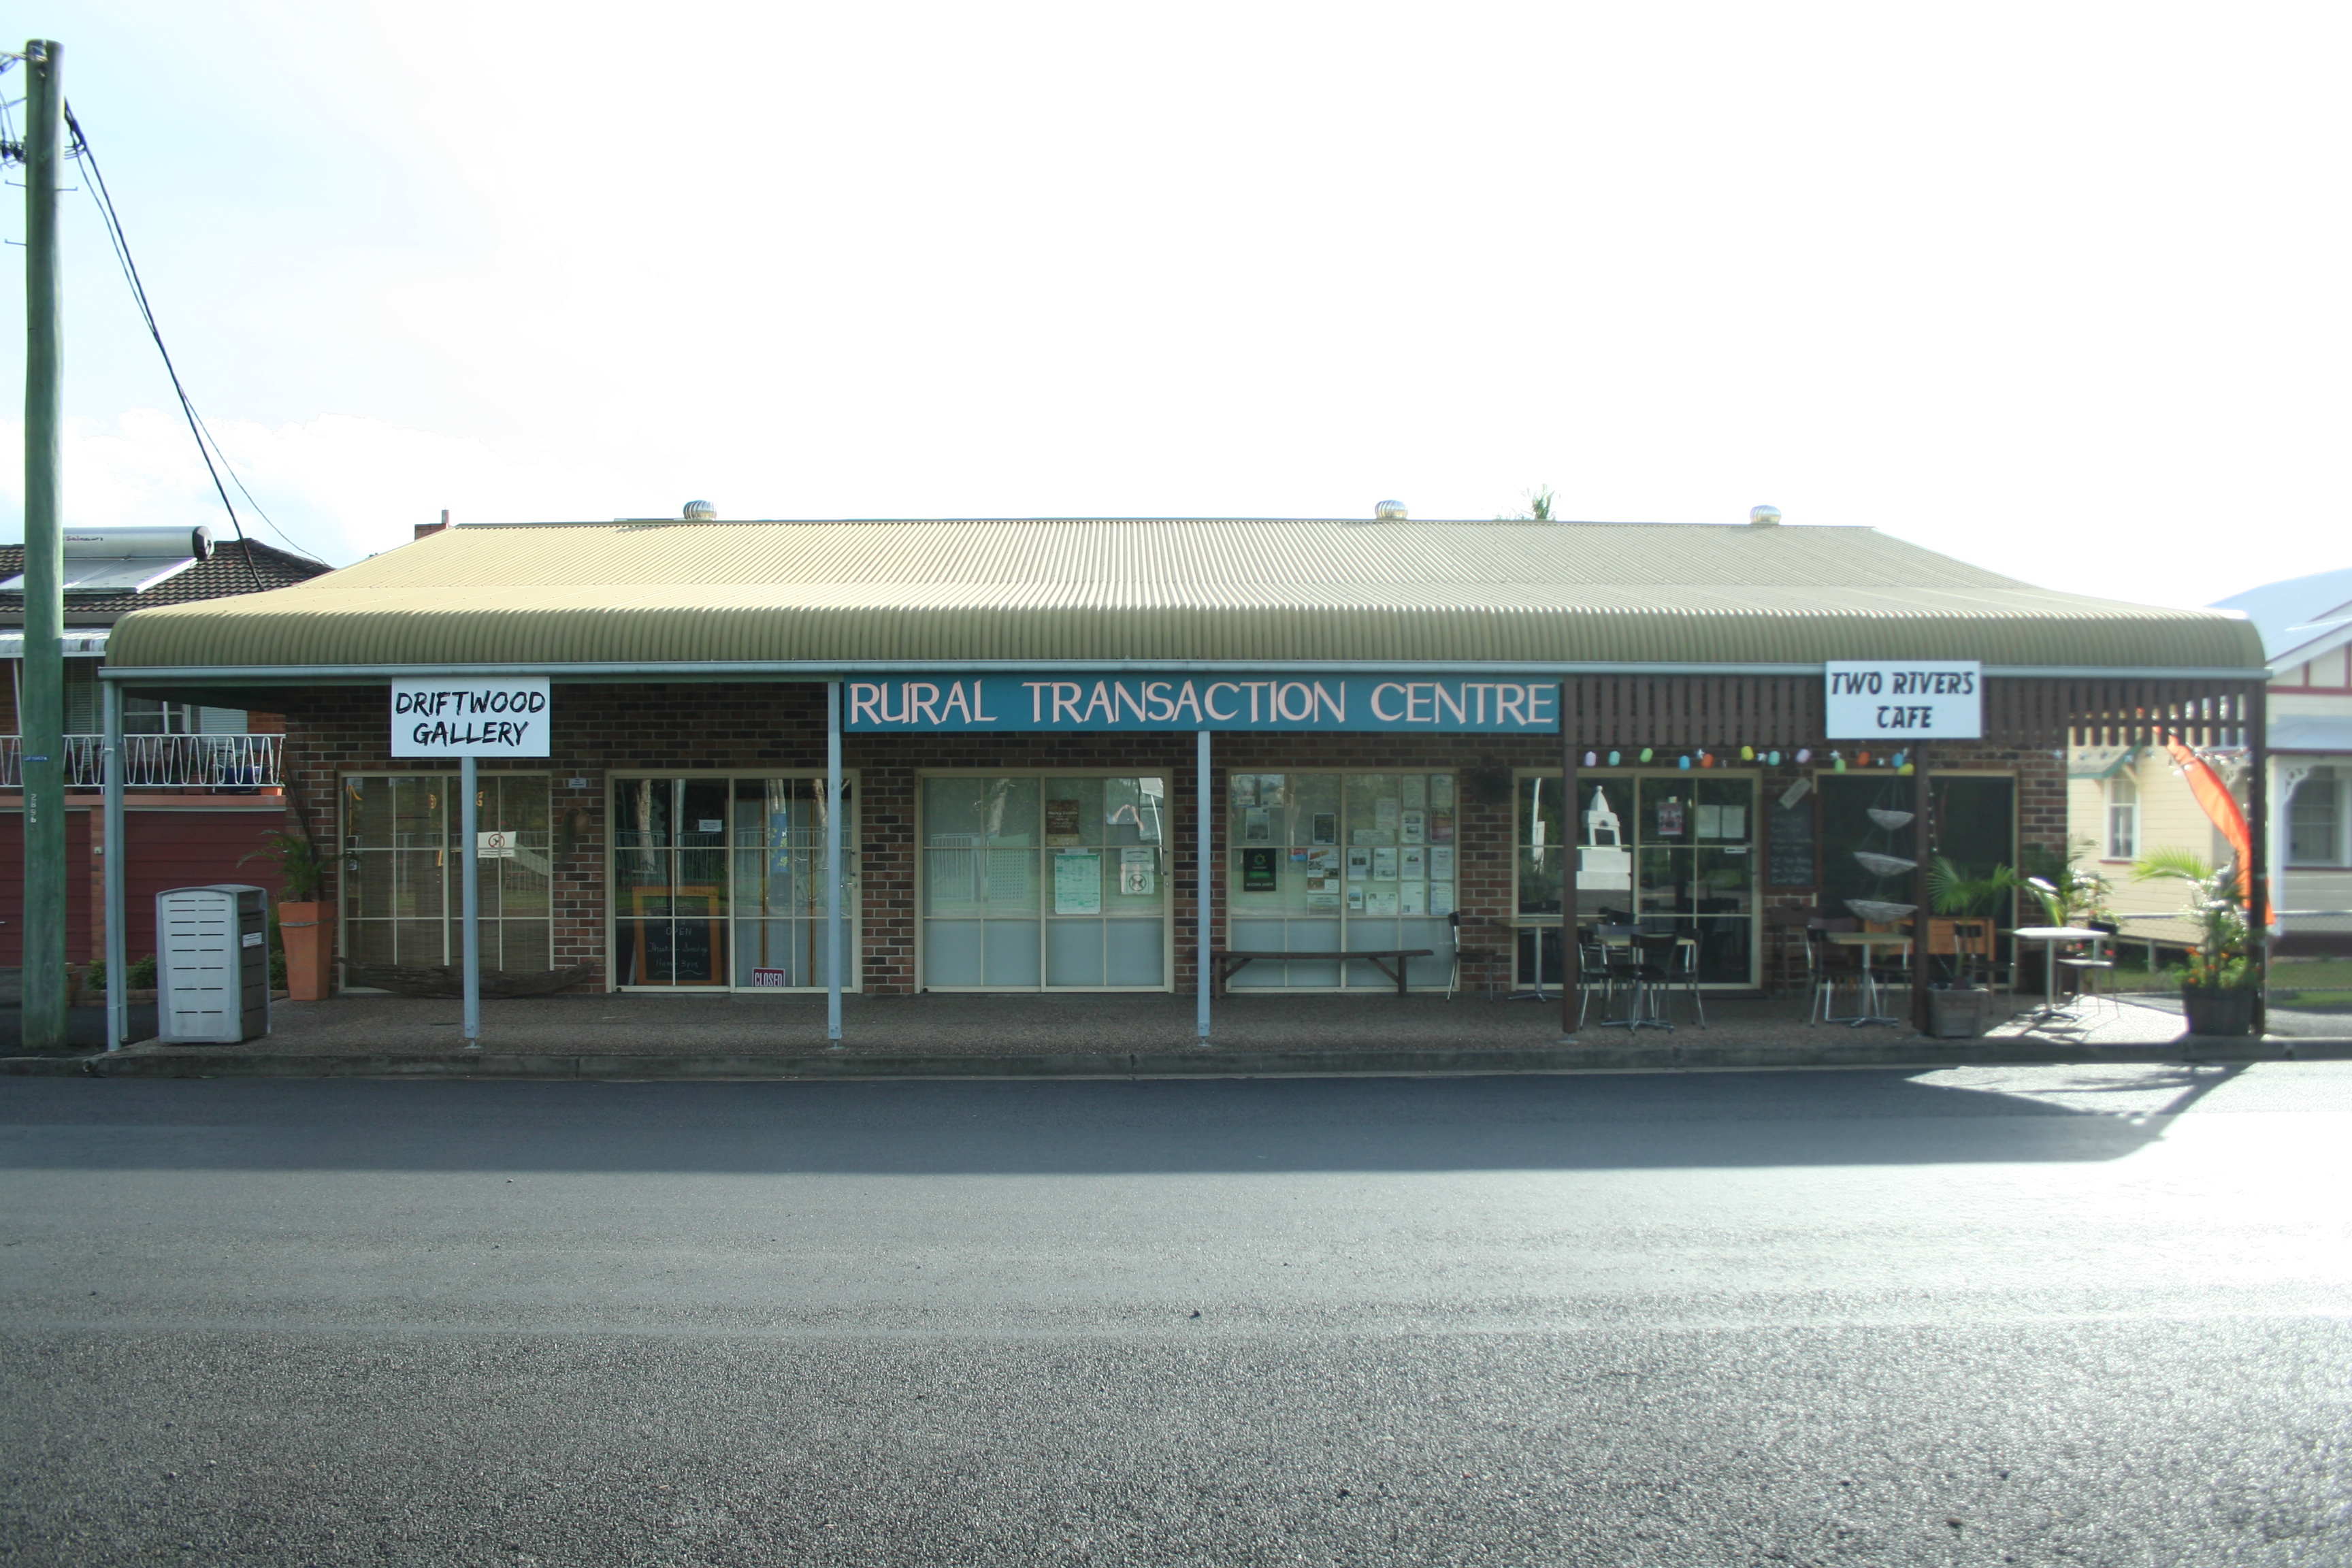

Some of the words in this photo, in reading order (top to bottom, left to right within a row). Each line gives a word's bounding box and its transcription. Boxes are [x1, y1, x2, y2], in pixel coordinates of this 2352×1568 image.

[1831, 671, 1882, 695] TWO
[1892, 671, 1974, 695] RIVERS
[395, 690, 546, 717] DRIFTWOOD
[849, 679, 998, 725] RURAL
[1022, 679, 1346, 724] TRANSACTION
[1371, 681, 1556, 726] CENTRE
[1876, 705, 1933, 728] CAFE
[413, 721, 529, 747] GALLERY
[755, 972, 783, 987] CLOSED
